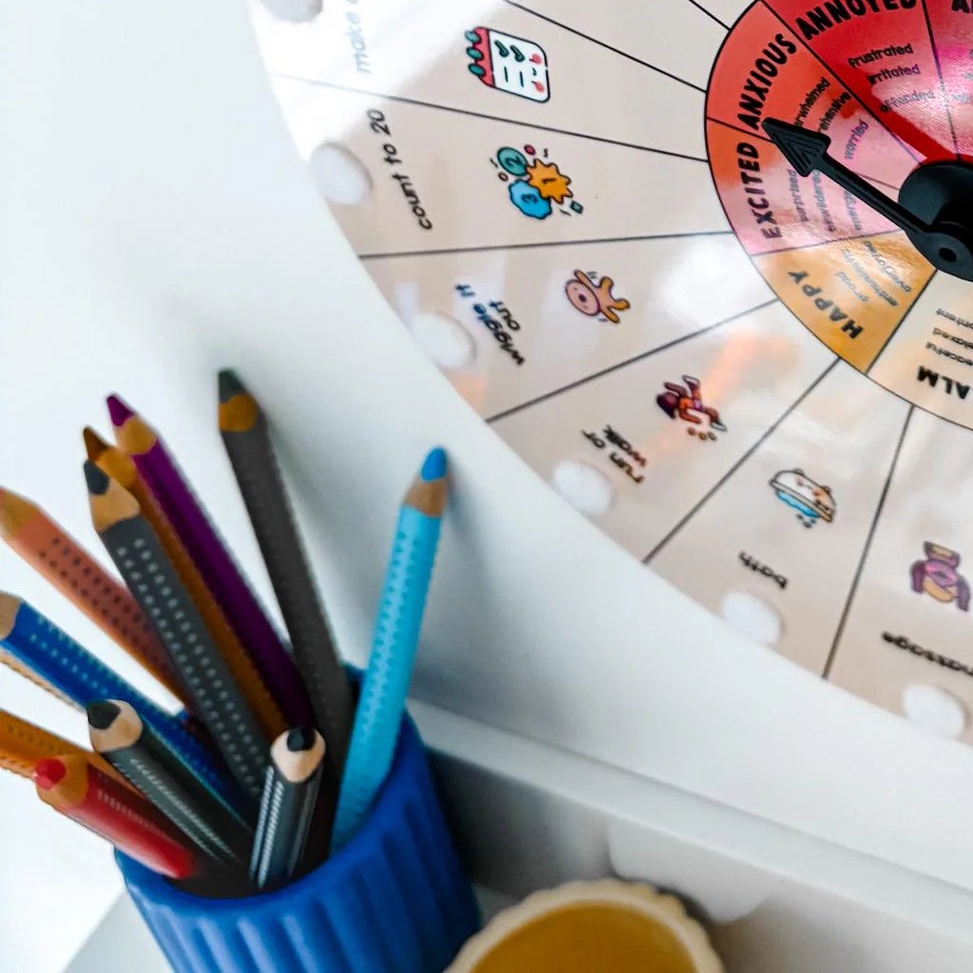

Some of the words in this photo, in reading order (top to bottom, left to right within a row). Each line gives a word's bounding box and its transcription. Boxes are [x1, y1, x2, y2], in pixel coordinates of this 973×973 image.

[345, 11, 371, 73] make
[848, 43, 913, 68] frustrated
[738, 33, 797, 130] ANXIOUS
[867, 64, 921, 83] irritated
[367, 109, 391, 136] 20
[793, 77, 830, 127] erwhelmed
[817, 92, 851, 133] ehensive
[383, 143, 402, 165] to
[845, 119, 869, 160] worried
[392, 172, 432, 230] count
[737, 141, 782, 239] EXCITED
[456, 284, 475, 297] it
[788, 270, 864, 339] HAPPY
[473, 304, 525, 365] wiggle
[489, 300, 520, 330] out
[581, 429, 605, 448] or
[603, 425, 646, 467] walk
[609, 452, 645, 483] run
[738, 551, 787, 590] bath
